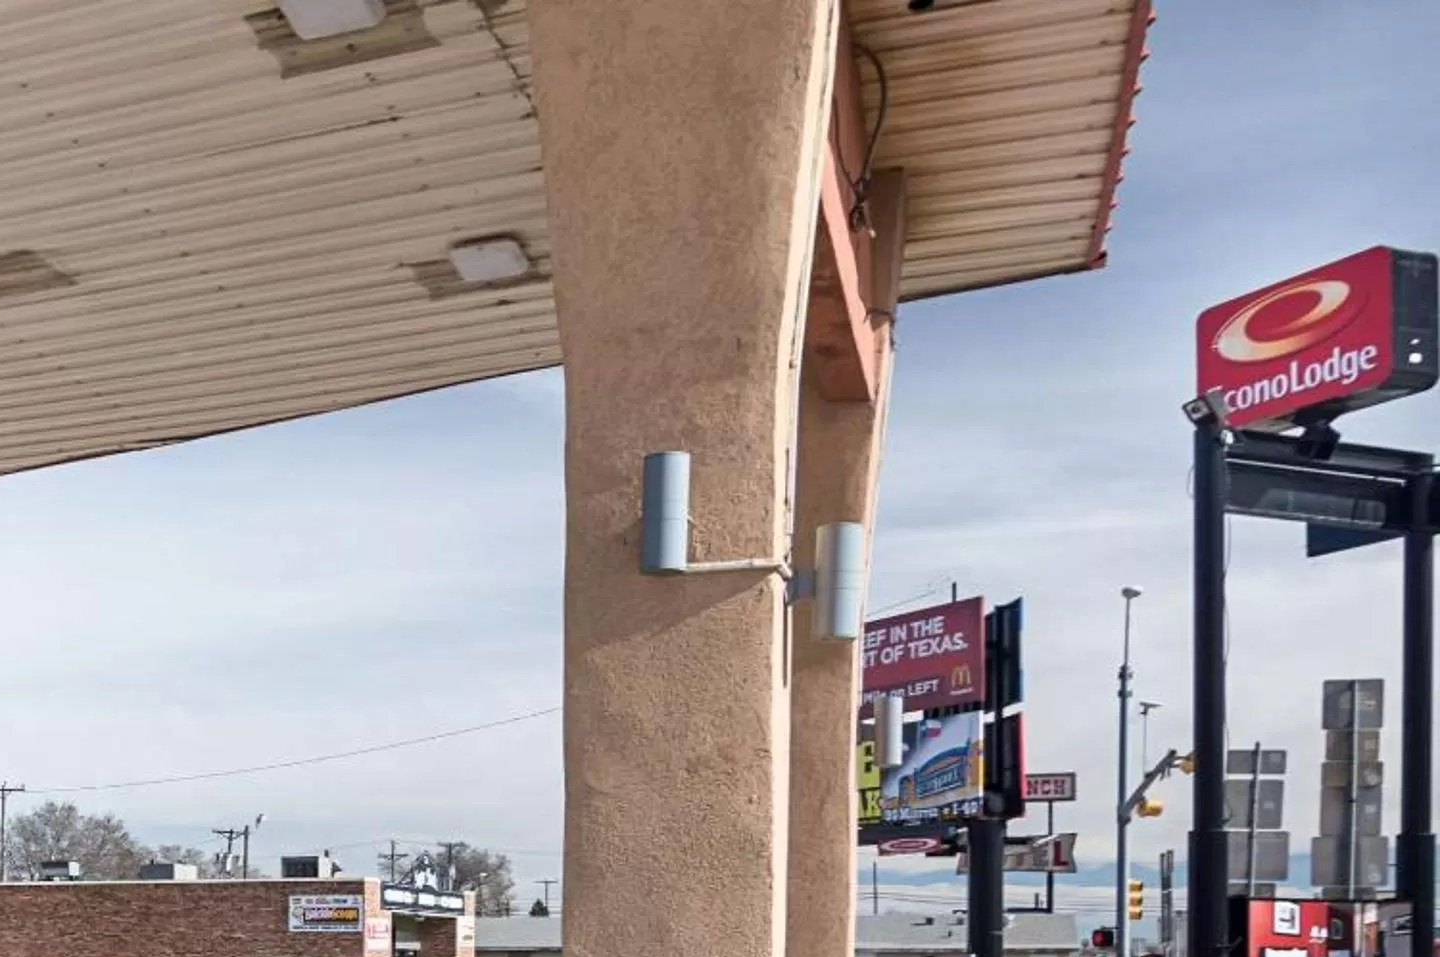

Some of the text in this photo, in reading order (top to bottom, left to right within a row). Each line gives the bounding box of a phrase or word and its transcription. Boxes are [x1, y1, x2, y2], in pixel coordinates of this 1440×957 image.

[889, 623, 908, 644] IN
[910, 615, 945, 639] THE
[880, 644, 905, 665] OF
[907, 679, 940, 697] LEFT
